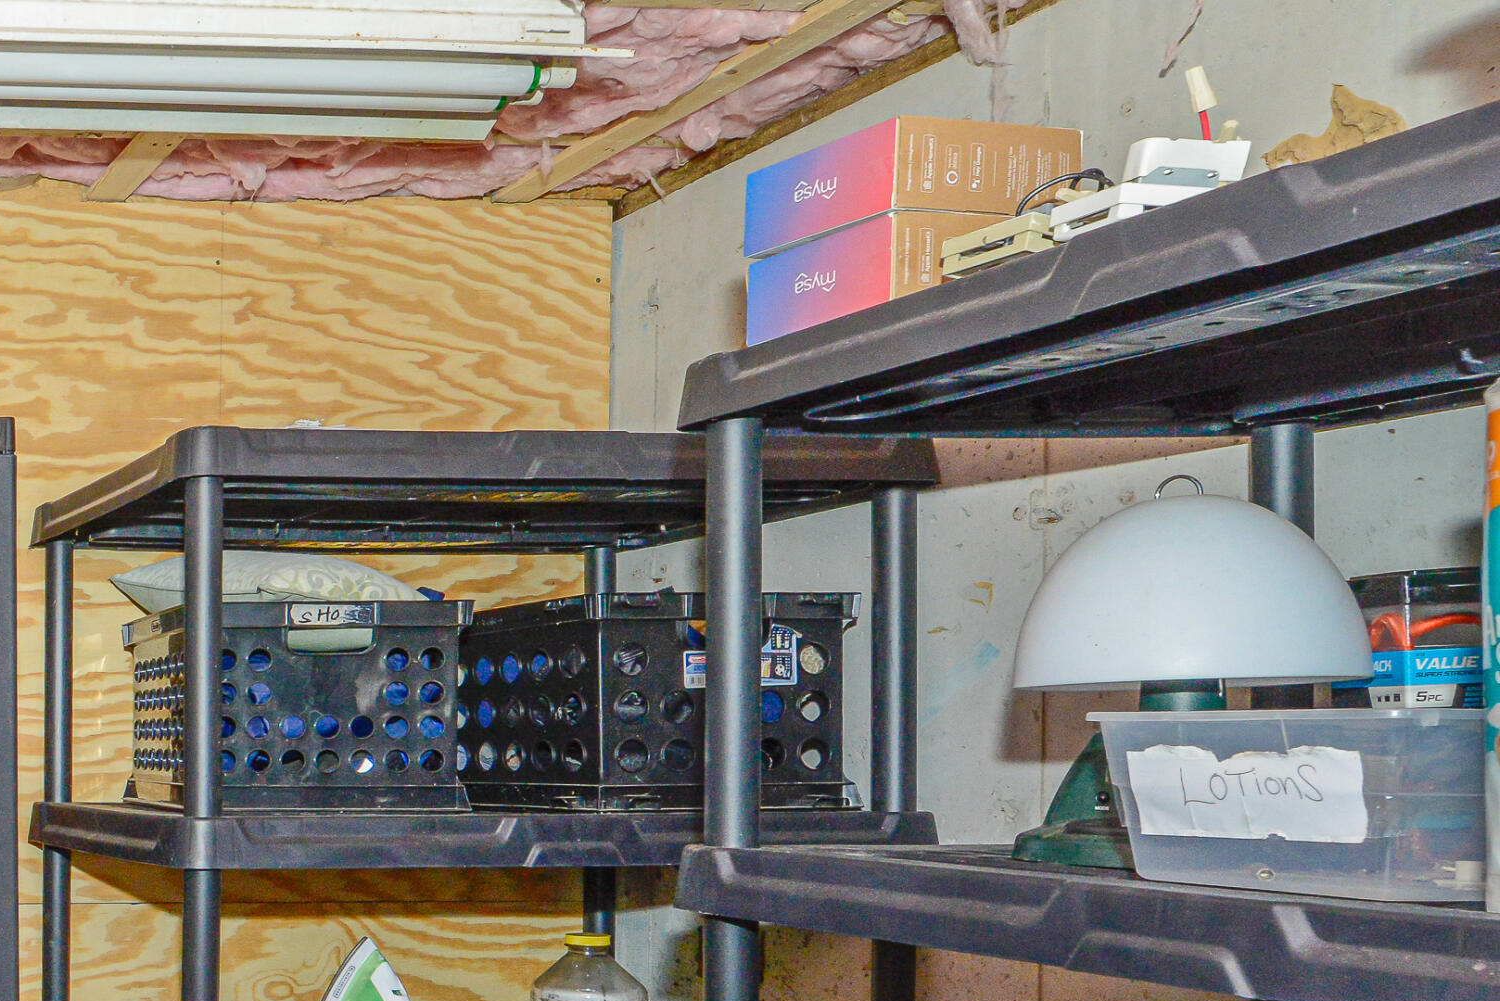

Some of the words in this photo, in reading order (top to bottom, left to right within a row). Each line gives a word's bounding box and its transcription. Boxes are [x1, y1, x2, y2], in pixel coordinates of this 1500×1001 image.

[794, 176, 837, 203] mysa
[794, 269, 836, 294] mysa
[1415, 656, 1480, 670] VALUE
